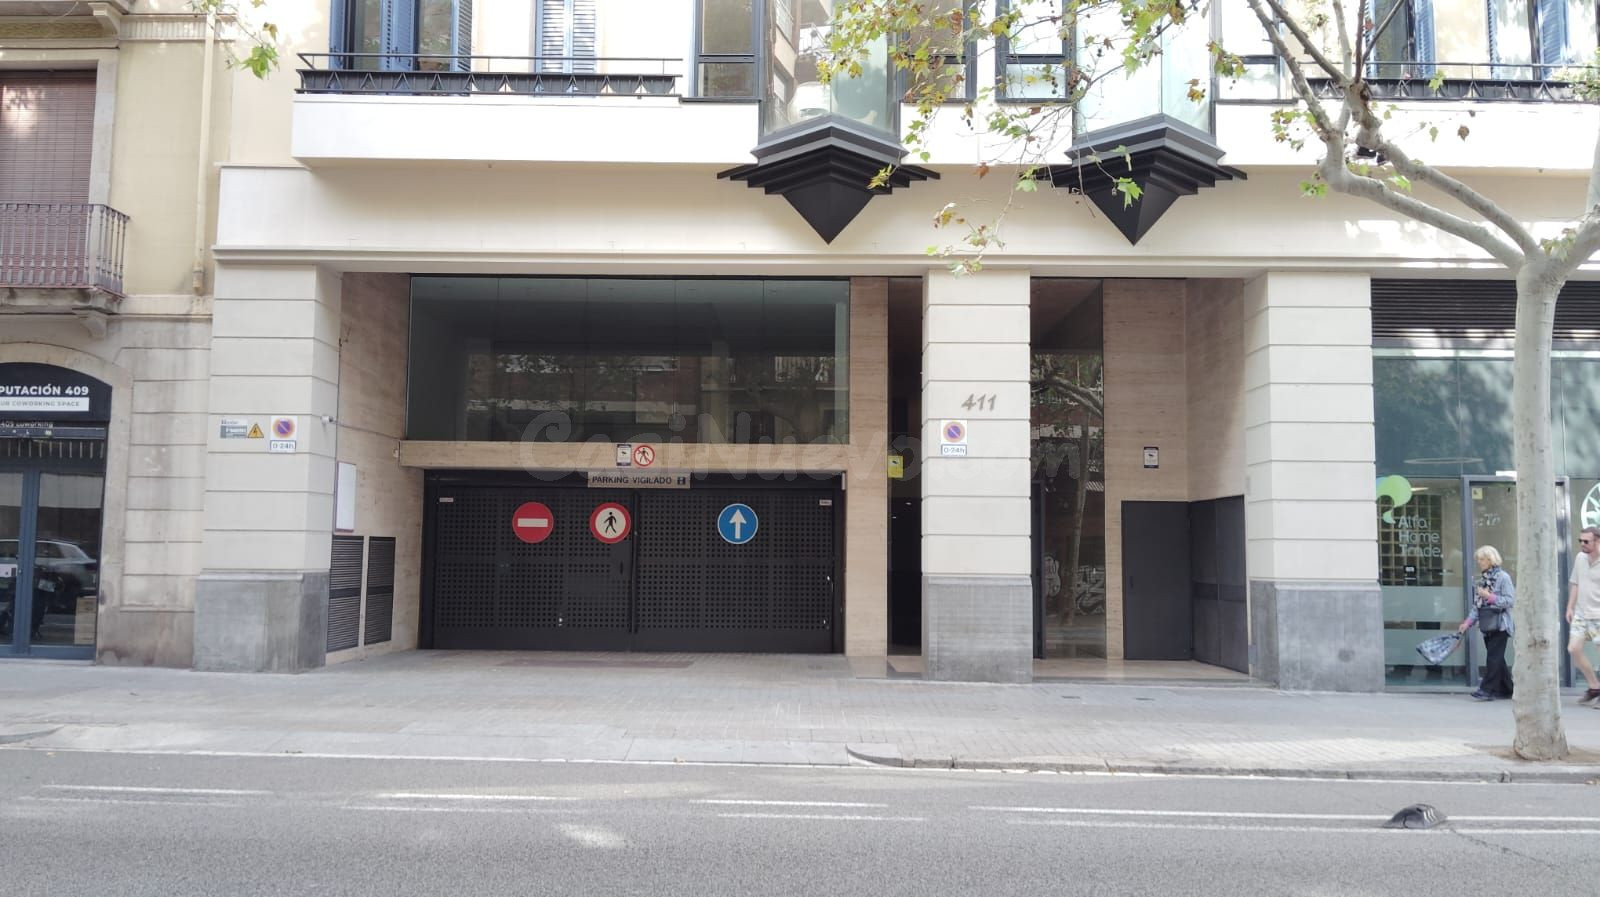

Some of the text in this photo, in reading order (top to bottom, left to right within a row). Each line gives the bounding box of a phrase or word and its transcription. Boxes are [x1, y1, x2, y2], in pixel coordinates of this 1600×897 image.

[65, 386, 89, 395] 409
[961, 393, 997, 411] 411
[592, 476, 629, 484] PARKING
[632, 476, 672, 485] VIGILADO
[1398, 515, 1428, 529] Alfa
[1398, 529, 1440, 543] Home
[1399, 543, 1444, 558] Trade.
